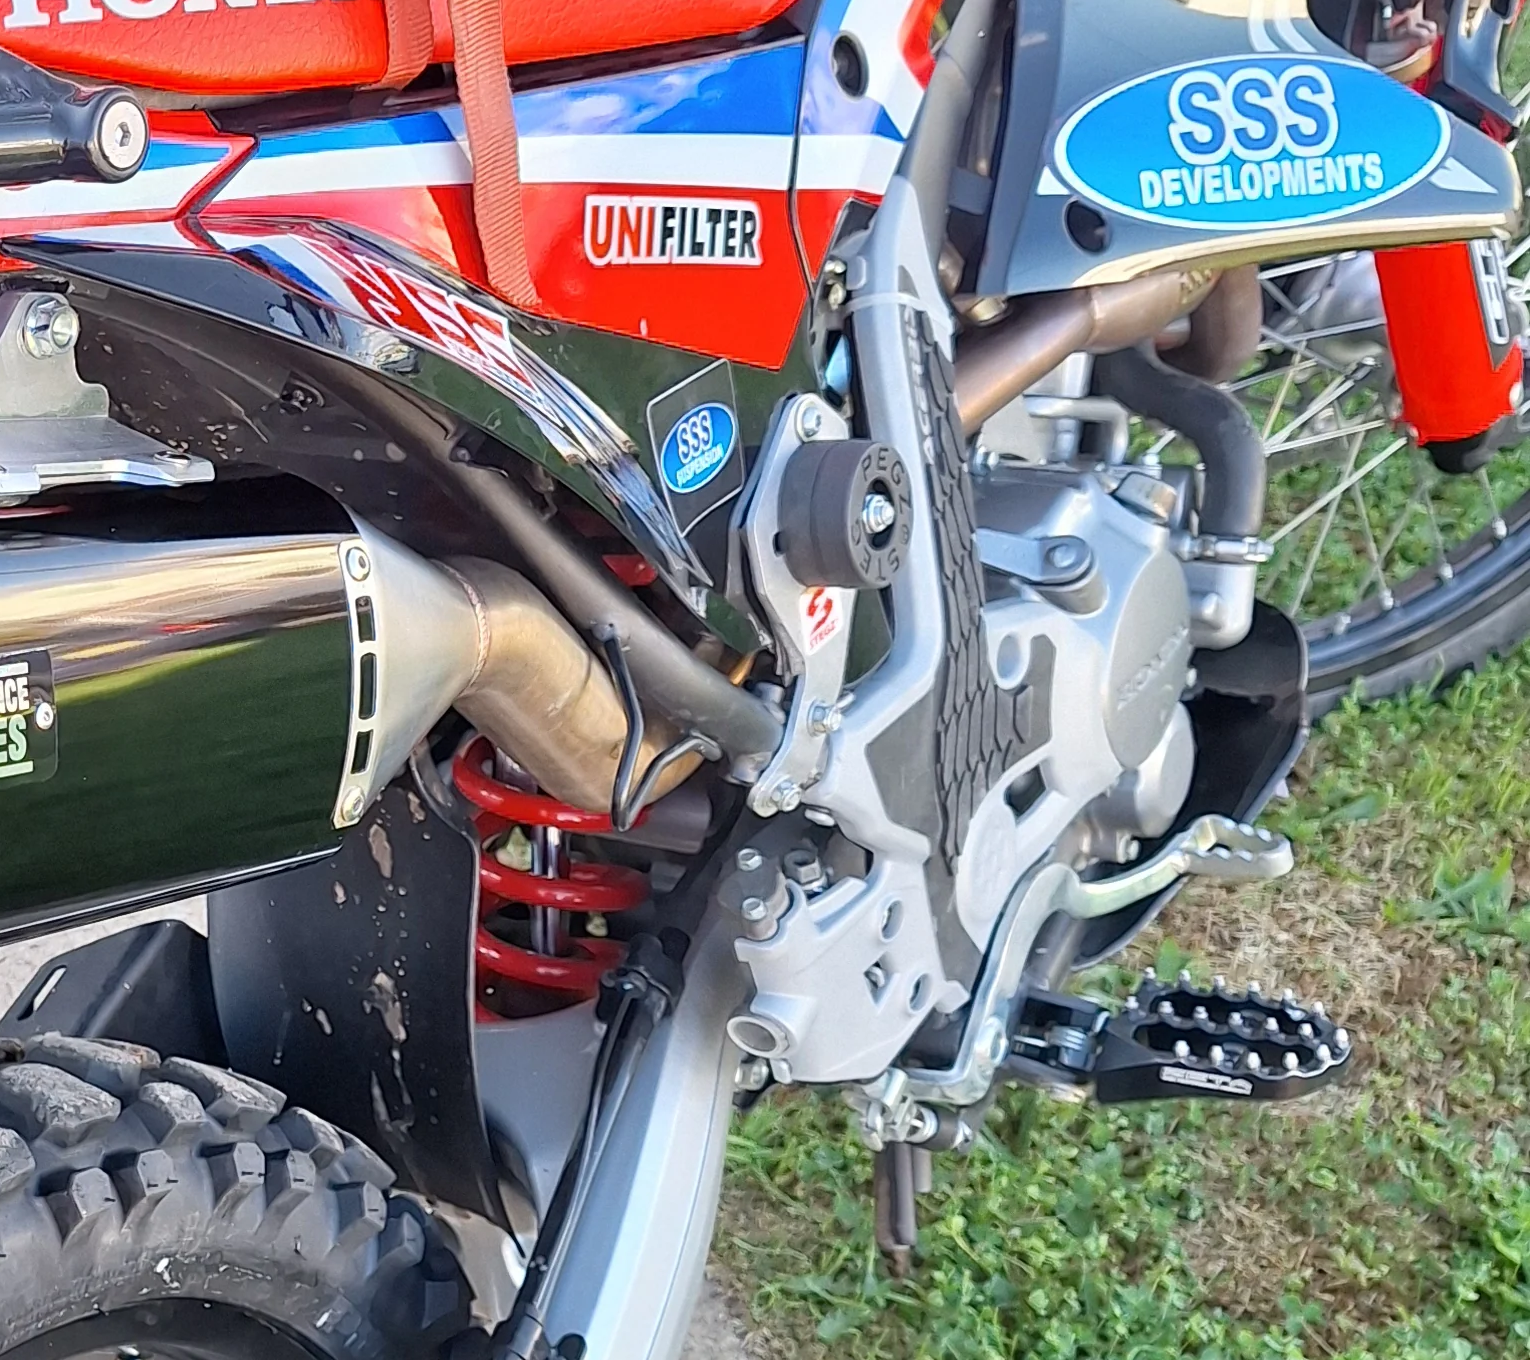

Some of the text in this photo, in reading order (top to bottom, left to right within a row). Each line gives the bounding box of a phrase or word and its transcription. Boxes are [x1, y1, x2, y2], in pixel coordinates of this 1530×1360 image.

[1168, 64, 1339, 166] SSS
[1139, 152, 1385, 209] DEVELOPMENTS
[589, 204, 758, 259] UNIFILTER
[677, 409, 714, 465] SSS
